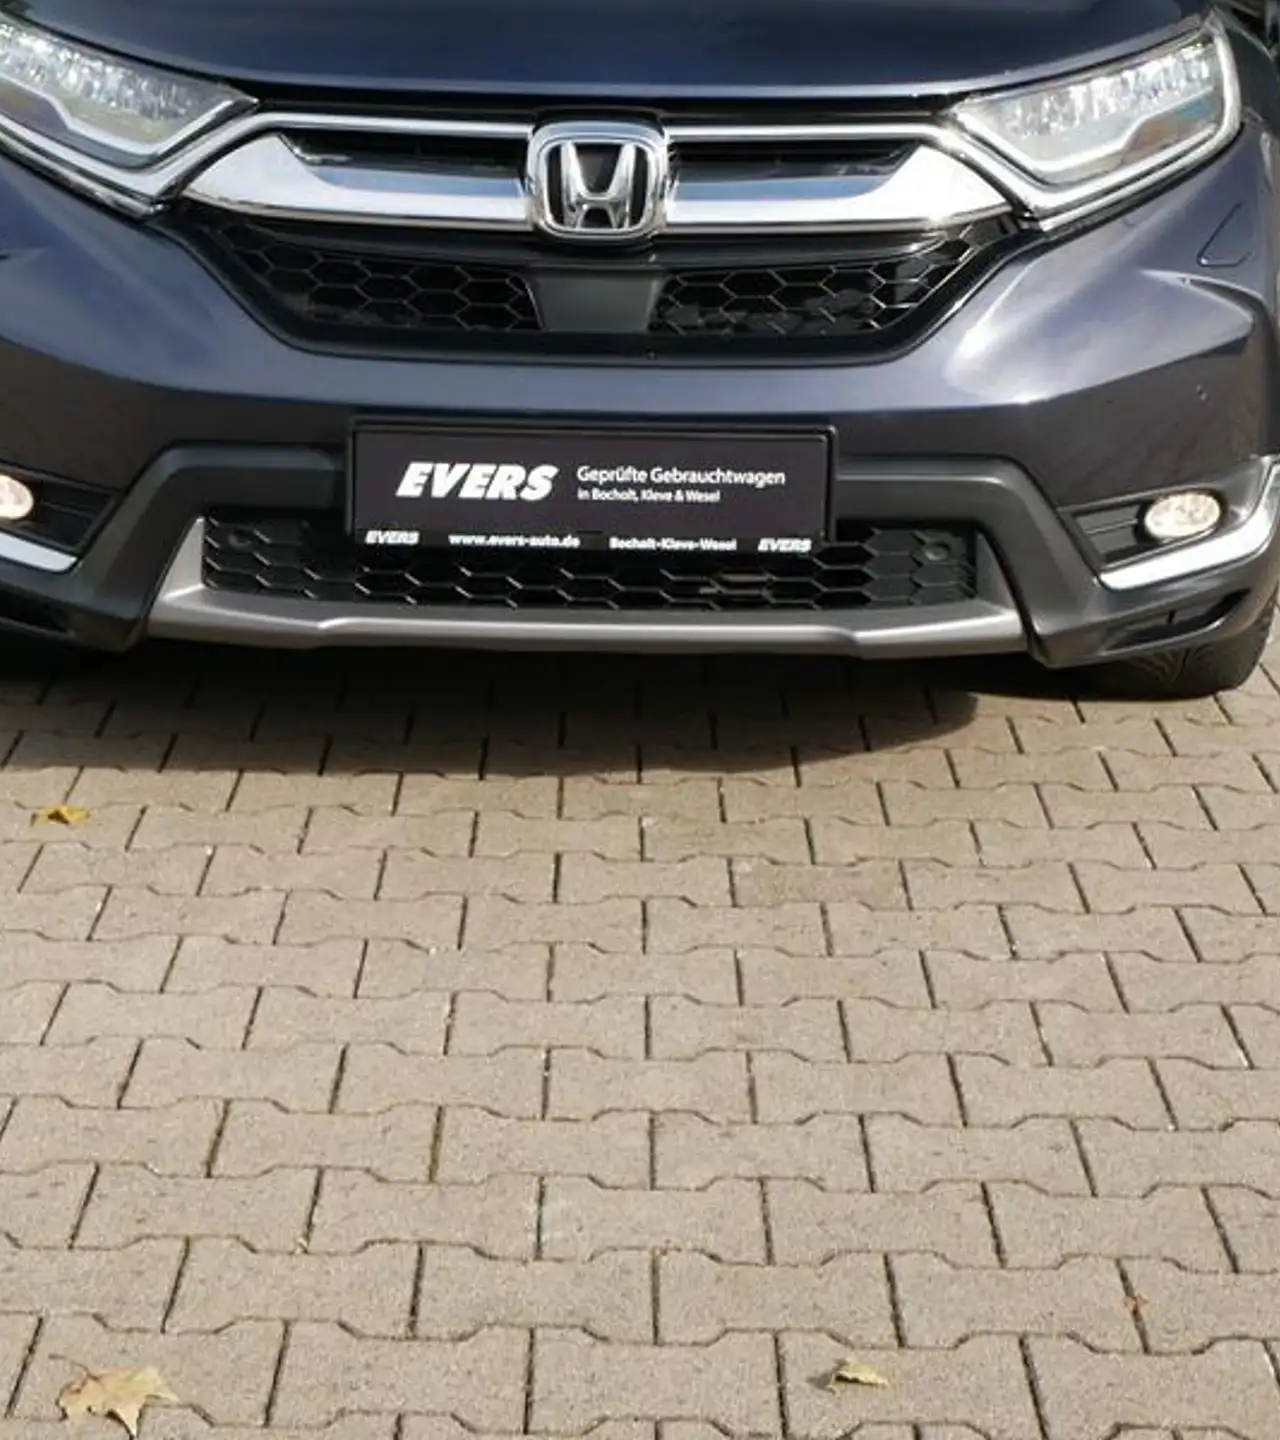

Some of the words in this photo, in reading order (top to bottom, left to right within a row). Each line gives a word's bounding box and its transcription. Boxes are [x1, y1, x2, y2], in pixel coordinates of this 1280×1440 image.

[394, 461, 560, 501] EVERS
[576, 465, 648, 486] Geprüfte
[649, 466, 787, 489] Gebrauchtwagen
[365, 529, 420, 546] EVERS
[448, 533, 581, 549] www.evers-auto.de
[757, 536, 812, 553] EVERS
